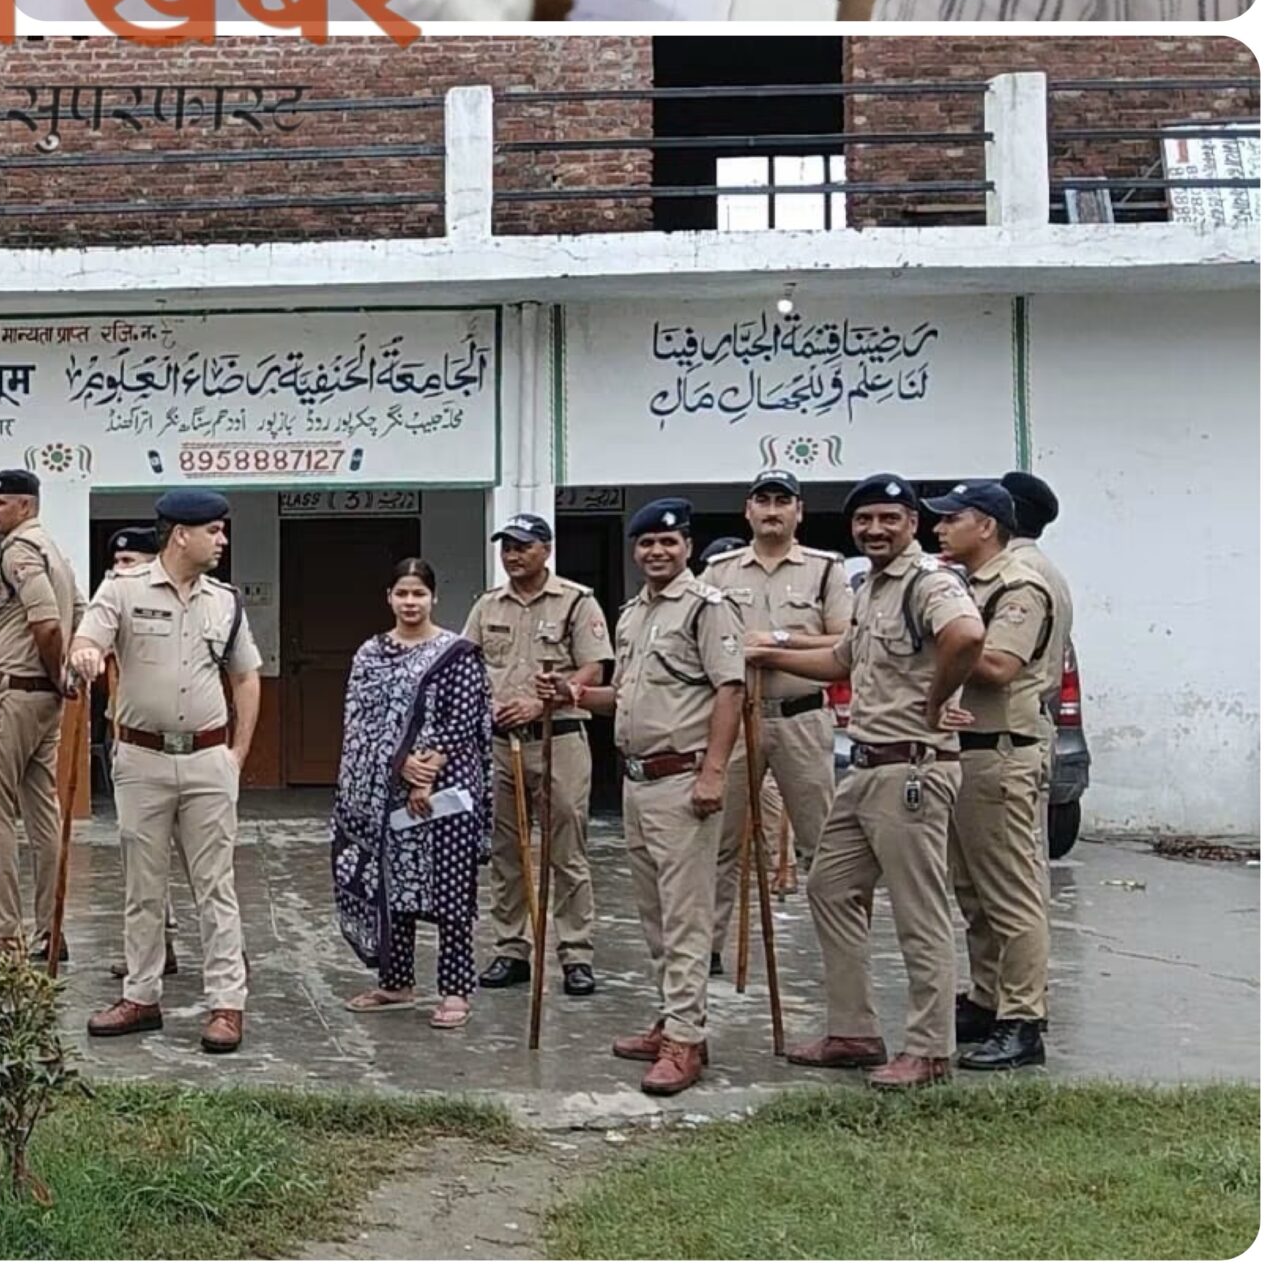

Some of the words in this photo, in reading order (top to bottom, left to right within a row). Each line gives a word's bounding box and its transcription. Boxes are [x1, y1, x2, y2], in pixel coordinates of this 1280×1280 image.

[1, 326, 54, 345] मान्यता
[56, 326, 92, 345] प्राप्त
[179, 448, 346, 473] 8958887127
